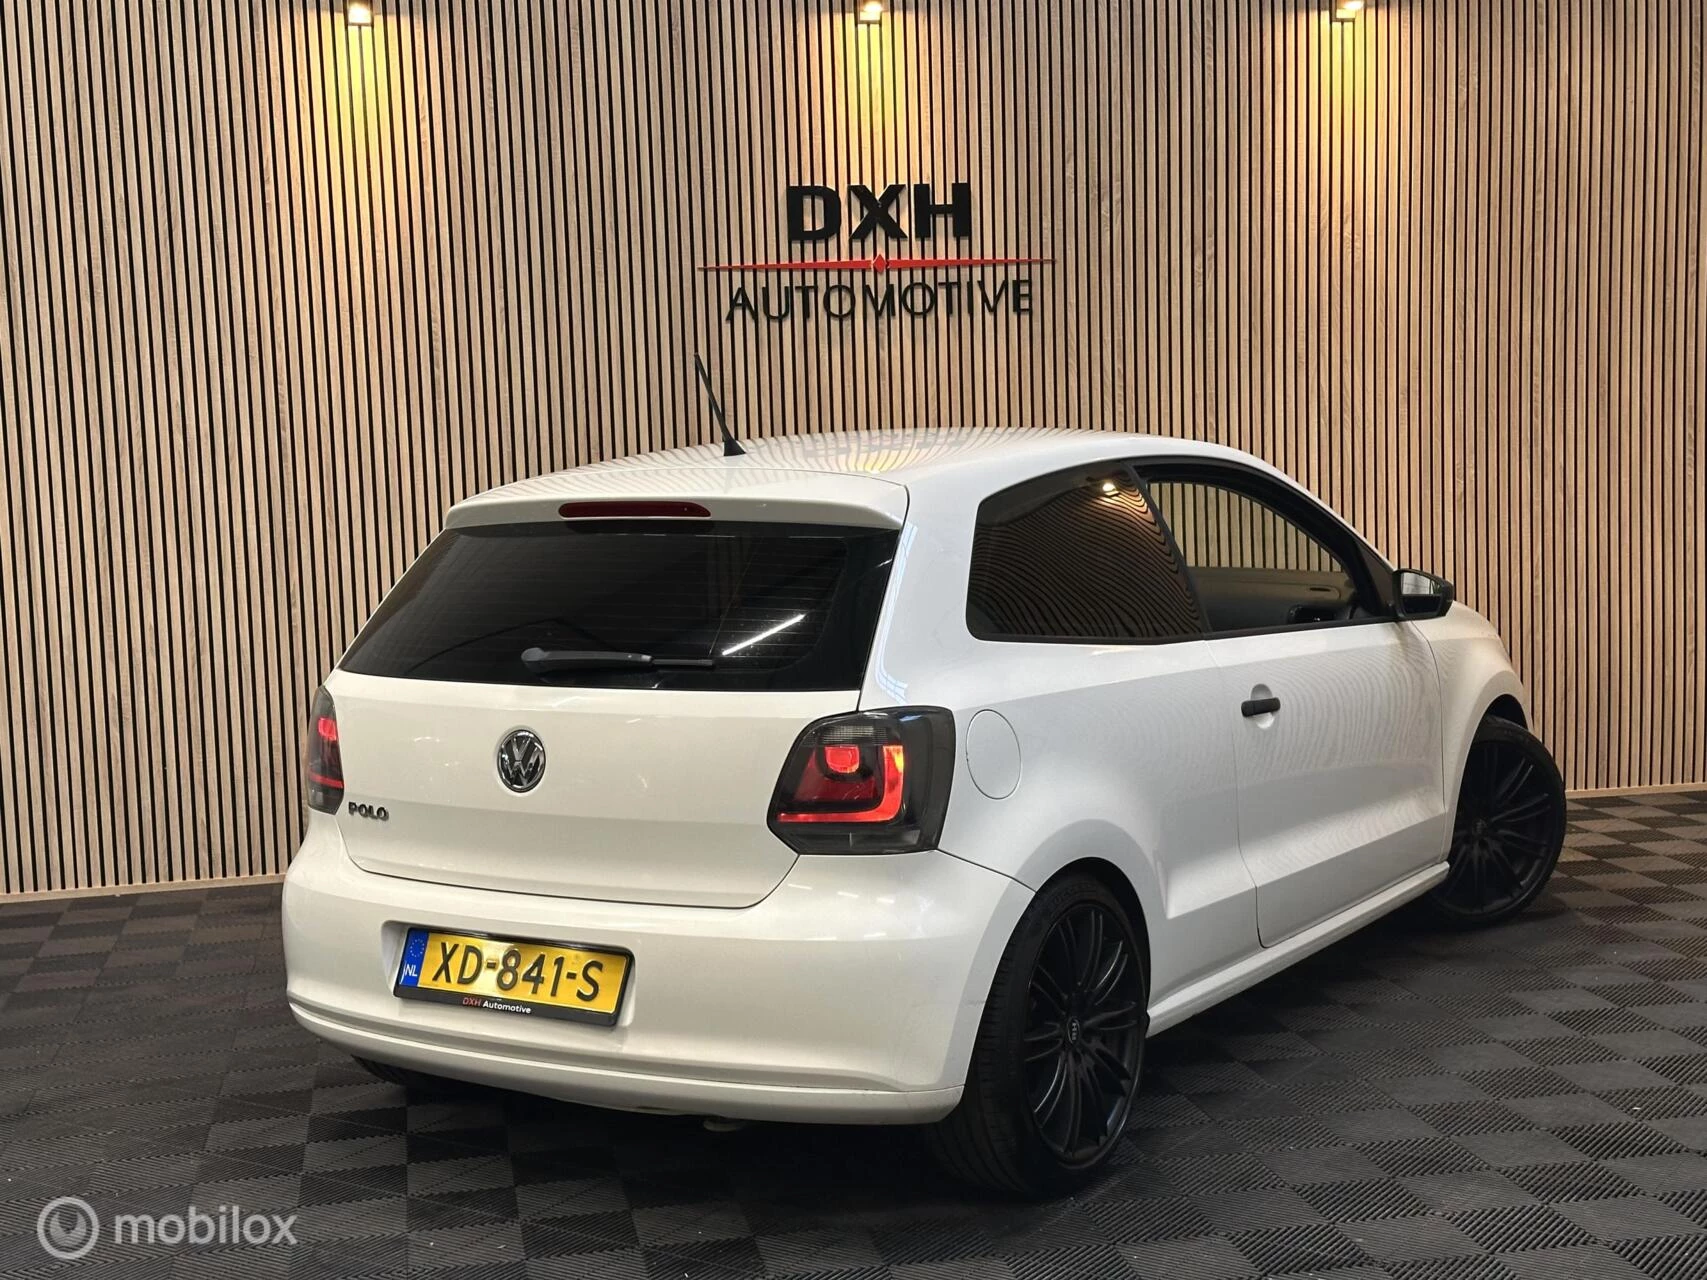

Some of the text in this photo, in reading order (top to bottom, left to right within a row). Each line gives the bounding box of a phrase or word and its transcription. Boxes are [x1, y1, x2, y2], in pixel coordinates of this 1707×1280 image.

[786, 183, 971, 241] DXH
[726, 280, 1033, 322] AUTOMOTIVE
[348, 802, 389, 821] POLO
[404, 965, 418, 978] NL
[432, 942, 603, 1002] XD-841-S
[462, 997, 532, 1014] DXH Automotive
